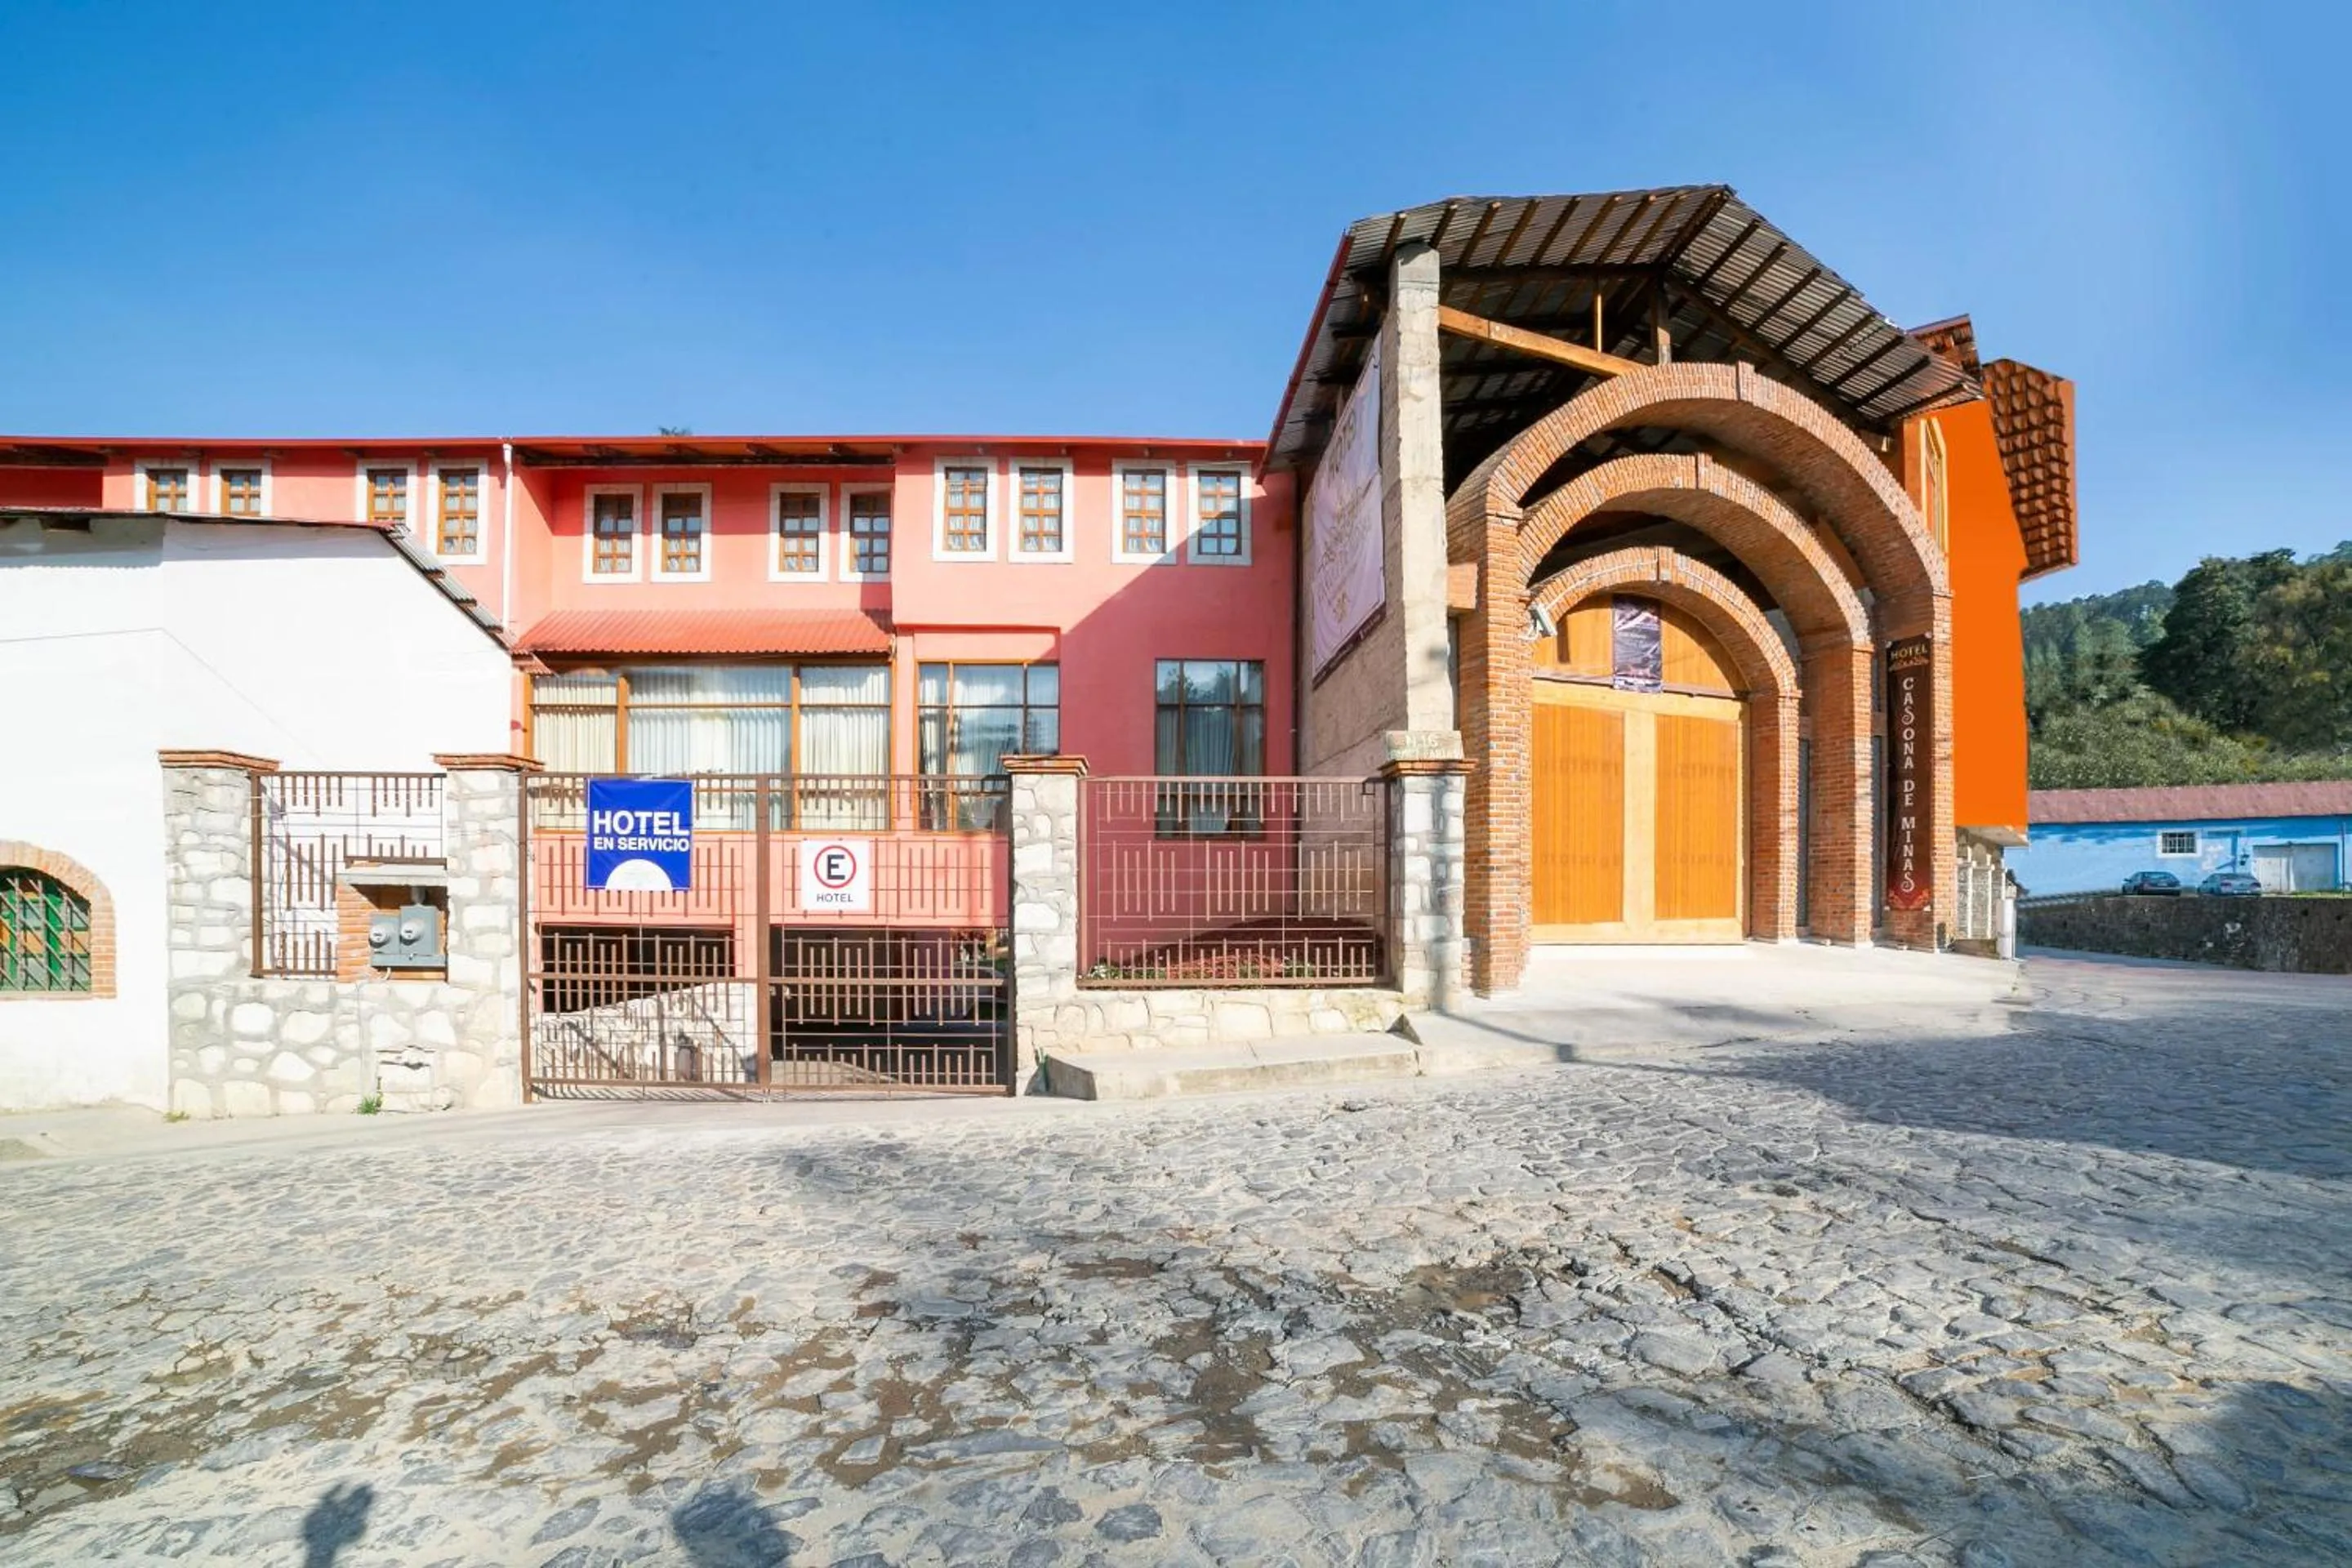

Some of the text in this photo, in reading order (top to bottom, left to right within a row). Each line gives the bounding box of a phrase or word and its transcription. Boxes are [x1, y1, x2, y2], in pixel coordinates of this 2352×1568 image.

[1891, 643, 1928, 660] HOTEL
[1901, 677, 1916, 893] CASONA DE MINAS
[592, 809, 689, 835] HOTEL
[594, 836, 689, 852] EN SERVICIO
[826, 854, 846, 880] E
[816, 893, 853, 902] HOTEL
